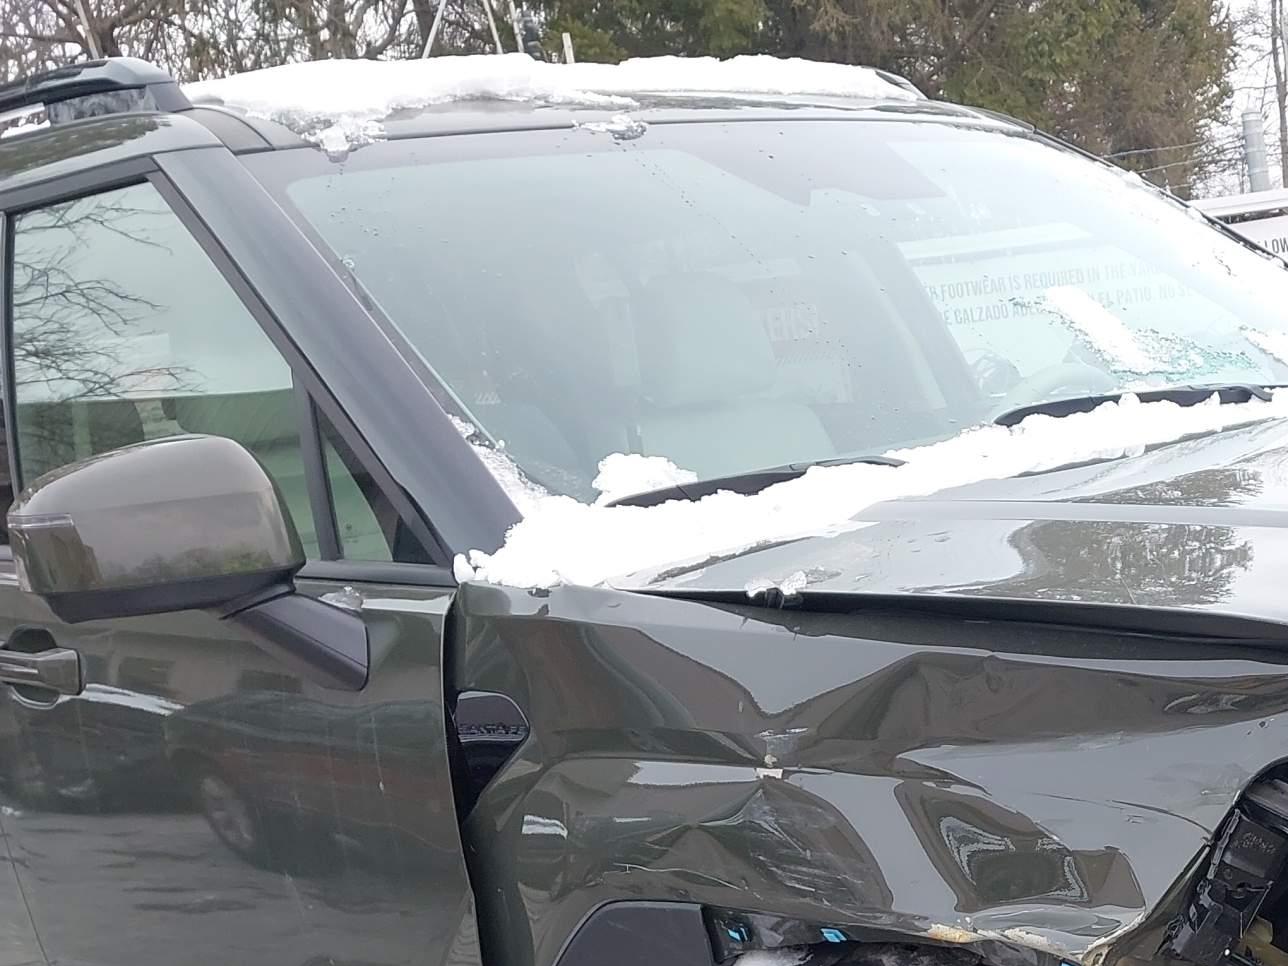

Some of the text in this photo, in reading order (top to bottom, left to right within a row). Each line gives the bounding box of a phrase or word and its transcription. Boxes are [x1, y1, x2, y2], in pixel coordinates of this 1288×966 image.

[941, 276, 1006, 302] FOOTWEAR
[1008, 273, 1021, 293] IS
[1024, 268, 1084, 290] REQUIRED
[1087, 265, 1100, 283] IN
[954, 302, 1009, 325] CALZADO
